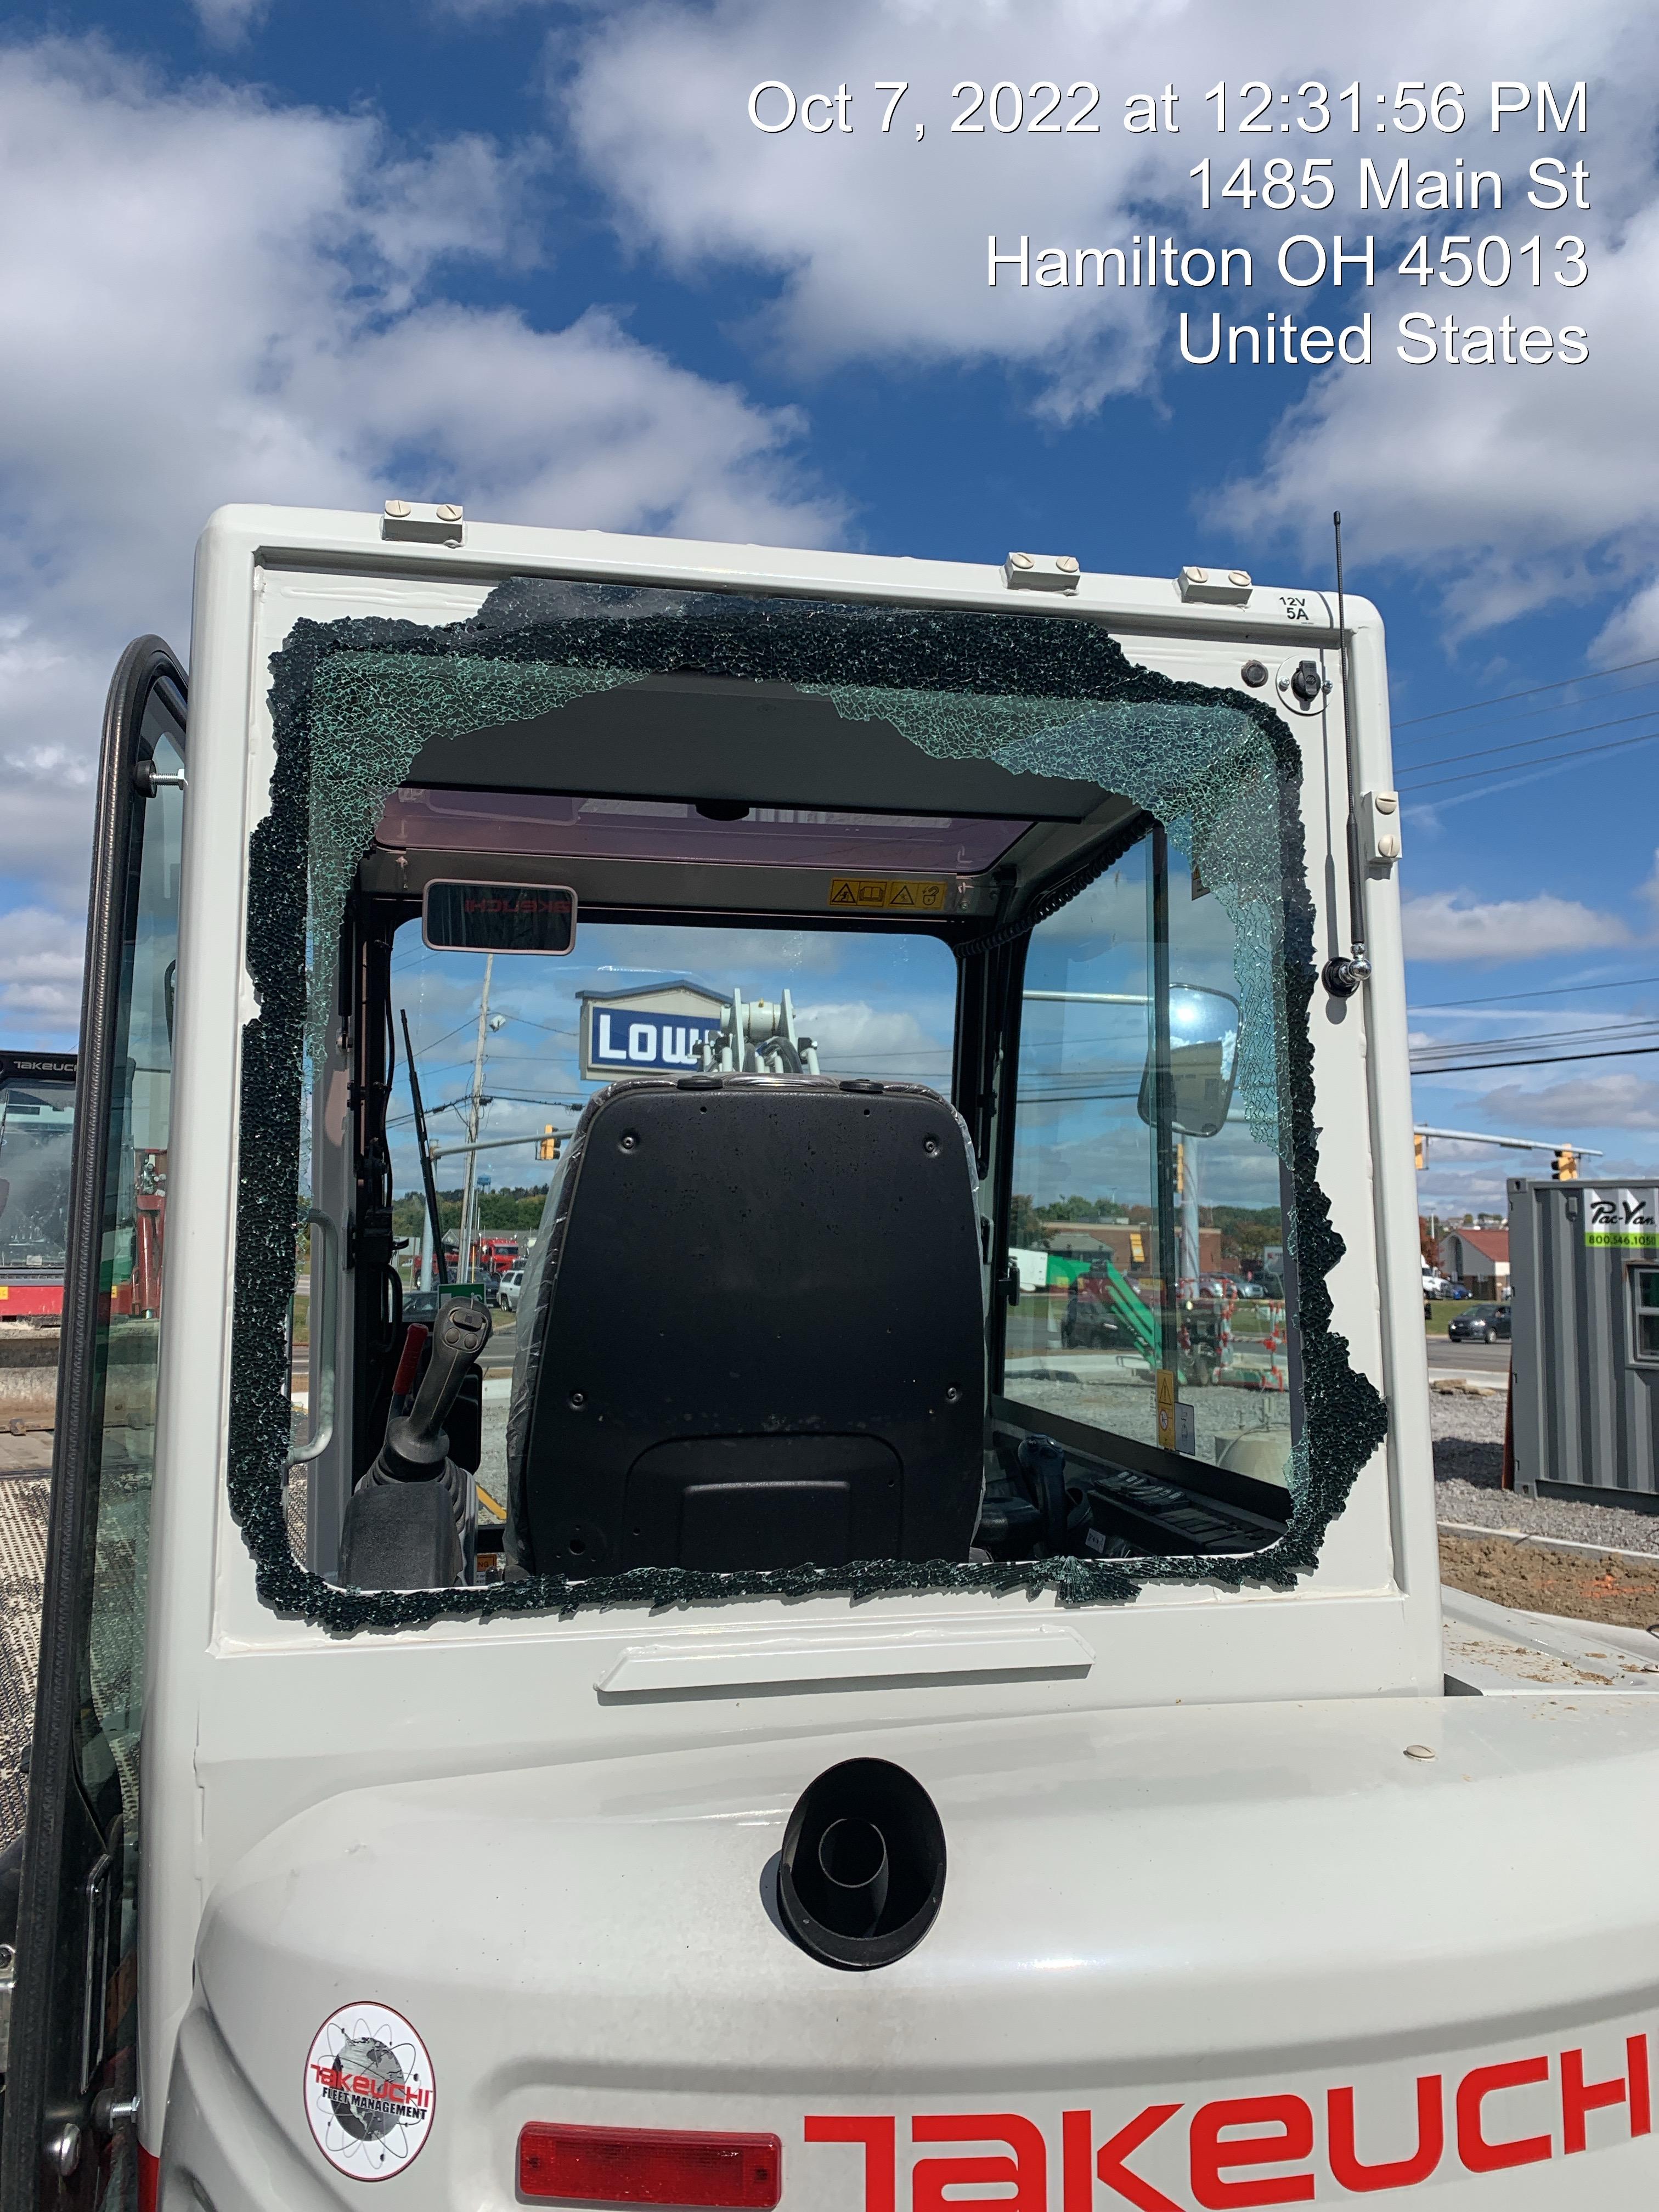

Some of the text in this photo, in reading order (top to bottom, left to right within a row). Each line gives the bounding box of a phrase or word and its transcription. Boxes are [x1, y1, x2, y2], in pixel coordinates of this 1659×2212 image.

[1279, 596, 1306, 607] 12V
[1286, 607, 1310, 620] 5A
[599, 1014, 723, 1065] LOW
[1590, 1200, 1655, 1225] Pac-Van
[322, 2086, 427, 2120] FLEET MANAGEMENT
